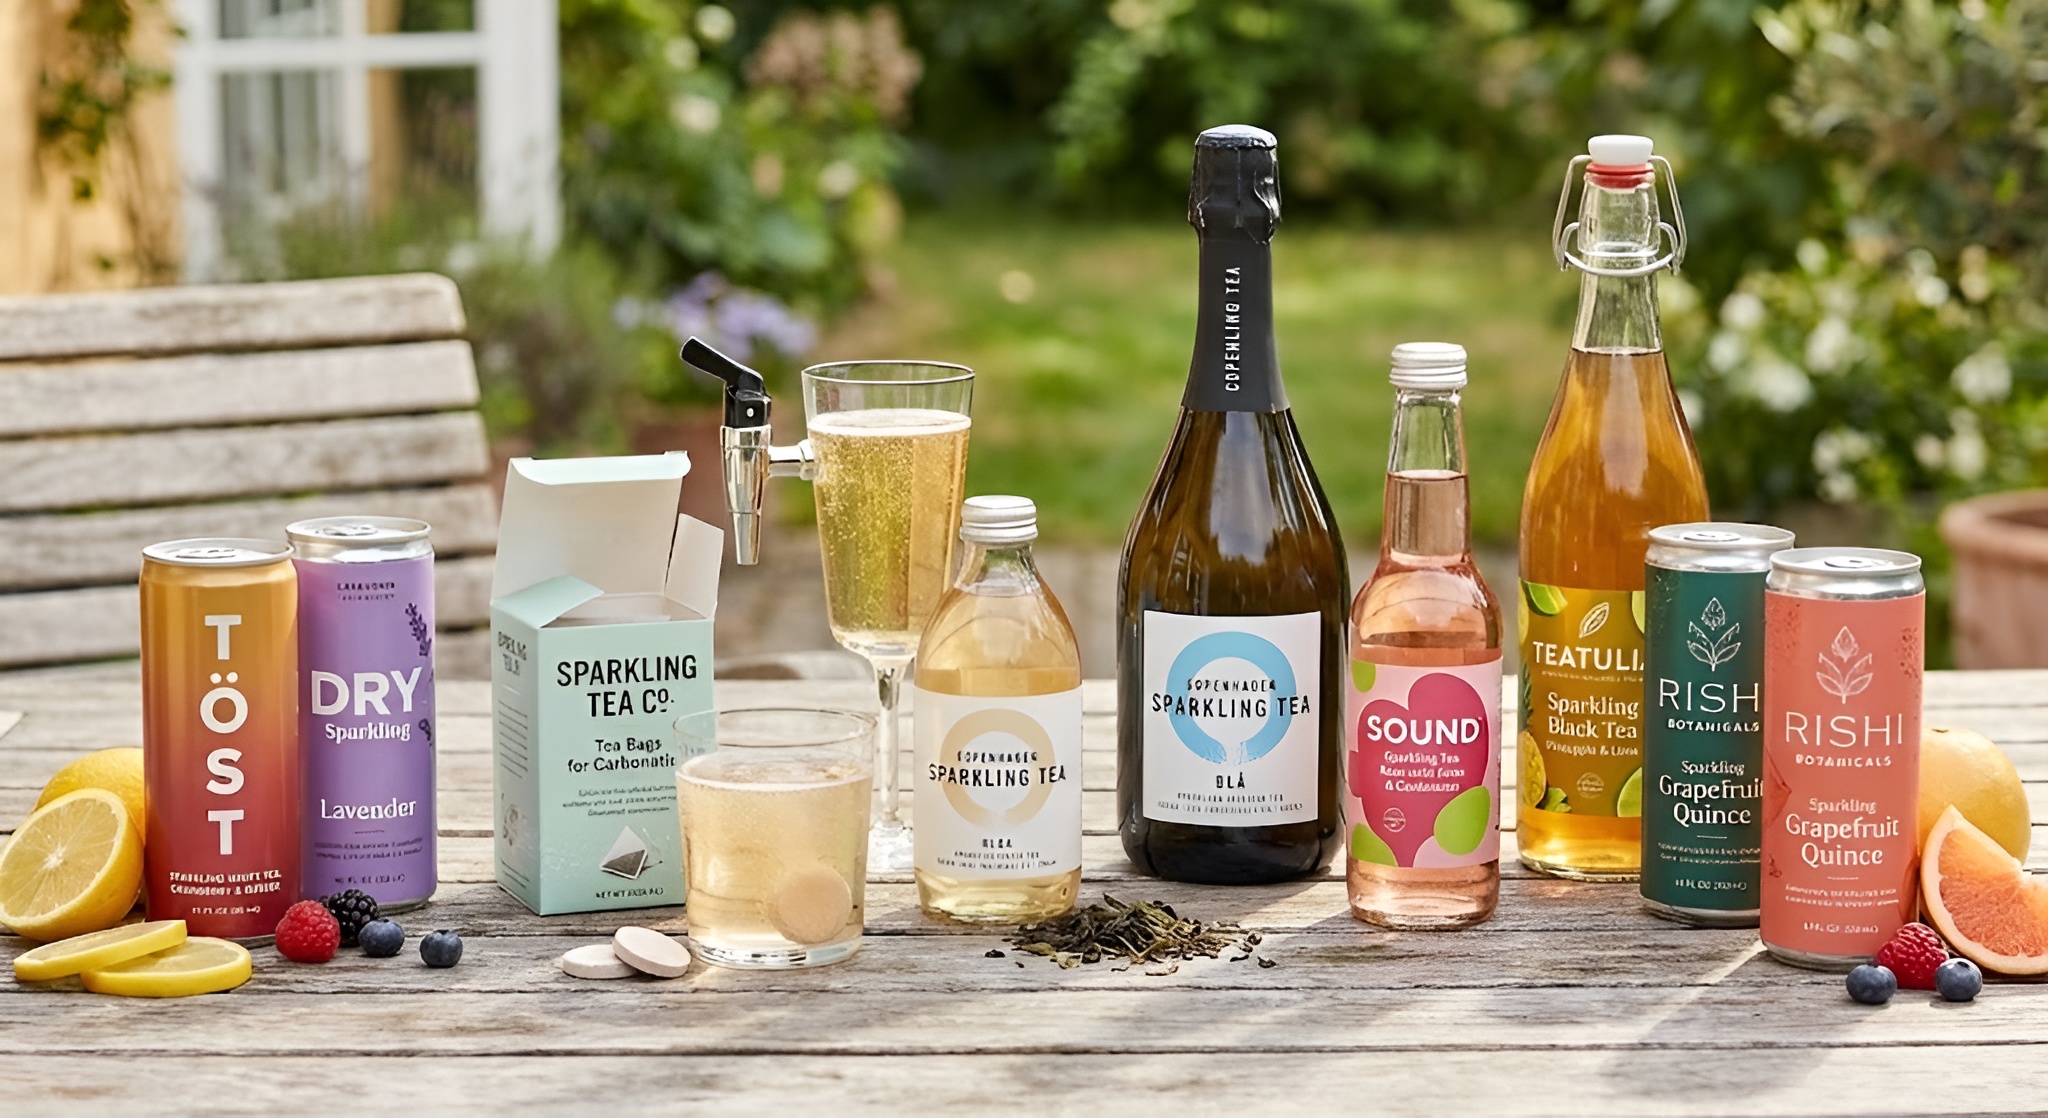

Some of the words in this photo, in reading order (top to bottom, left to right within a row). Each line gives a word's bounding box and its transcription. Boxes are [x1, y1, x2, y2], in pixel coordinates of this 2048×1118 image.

[1225, 267, 1241, 294] TEA
[557, 655, 697, 687] SPARKLING
[1532, 641, 1645, 672] TEATULI
[311, 666, 423, 716] DRY
[587, 690, 634, 717] TEA
[1152, 692, 1267, 718] SPARKLING
[1277, 694, 1311, 717] TEA
[1547, 691, 1639, 720] Sparkling
[1659, 677, 1759, 713] RISH
[200, 614, 248, 855] TÖST
[1367, 715, 1480, 746] SOUND
[1601, 721, 1637, 739] Tea
[1785, 710, 1903, 748] RISHI
[928, 763, 1030, 787] SPARKLING
[1039, 765, 1067, 785] TEA
[320, 797, 417, 820] Lavender
[1673, 802, 1752, 828] Quince
[1785, 813, 1900, 844] Grapefruit
[1801, 842, 1884, 869] Quince
